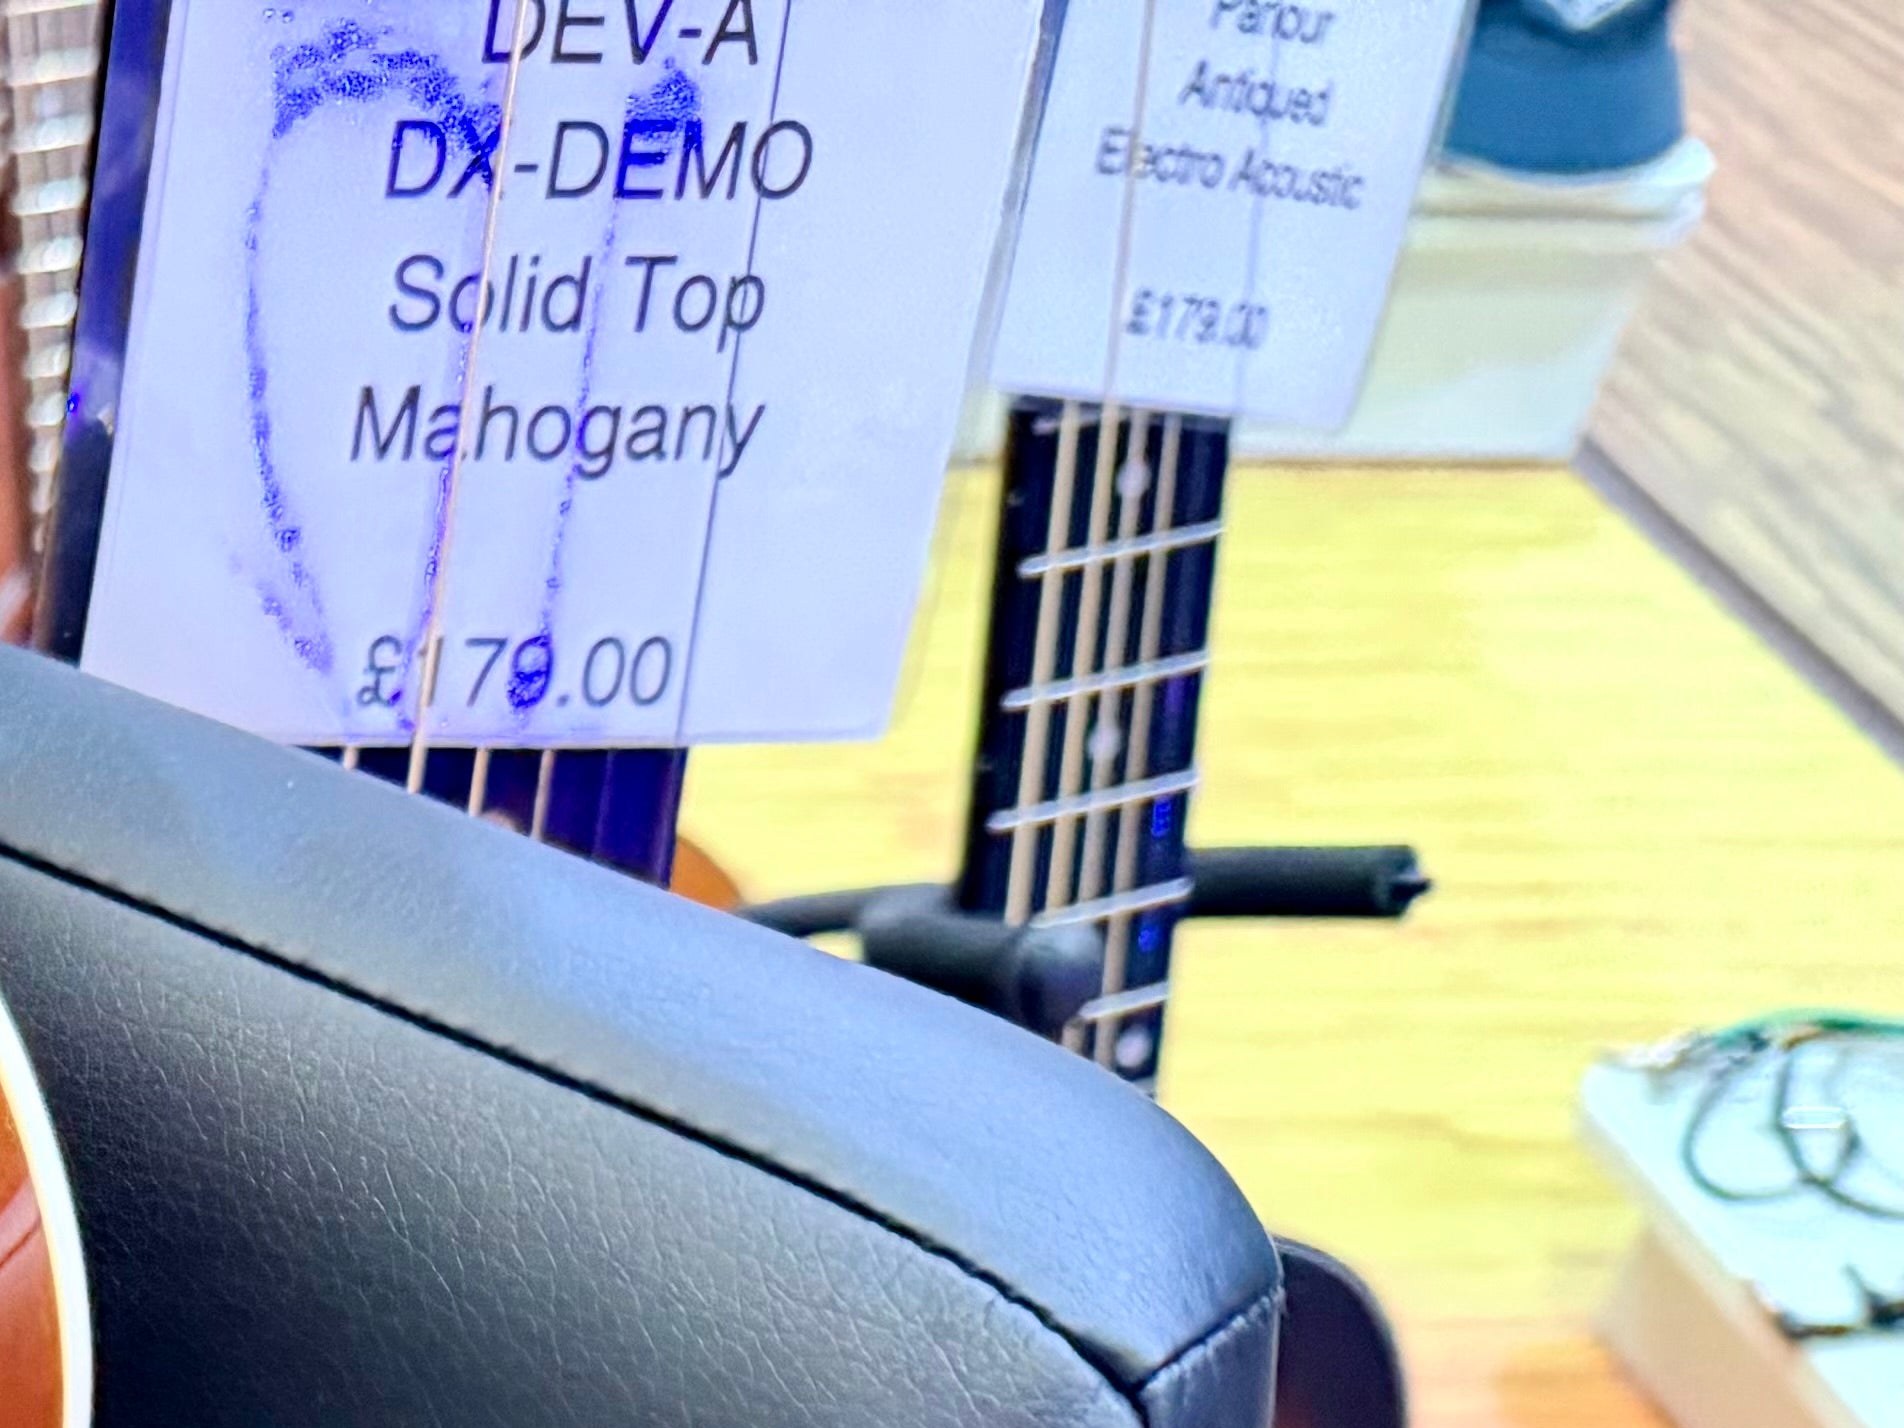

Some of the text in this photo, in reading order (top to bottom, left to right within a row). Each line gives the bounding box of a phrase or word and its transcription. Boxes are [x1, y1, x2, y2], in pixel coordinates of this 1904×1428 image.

[481, 0, 759, 65] DEV-A
[385, 119, 814, 200] DX-DEMO
[388, 253, 766, 354] Solid Top
[1126, 287, 1270, 350] £179.00
[349, 384, 766, 480] Mahogany
[356, 634, 673, 711] £179.00
